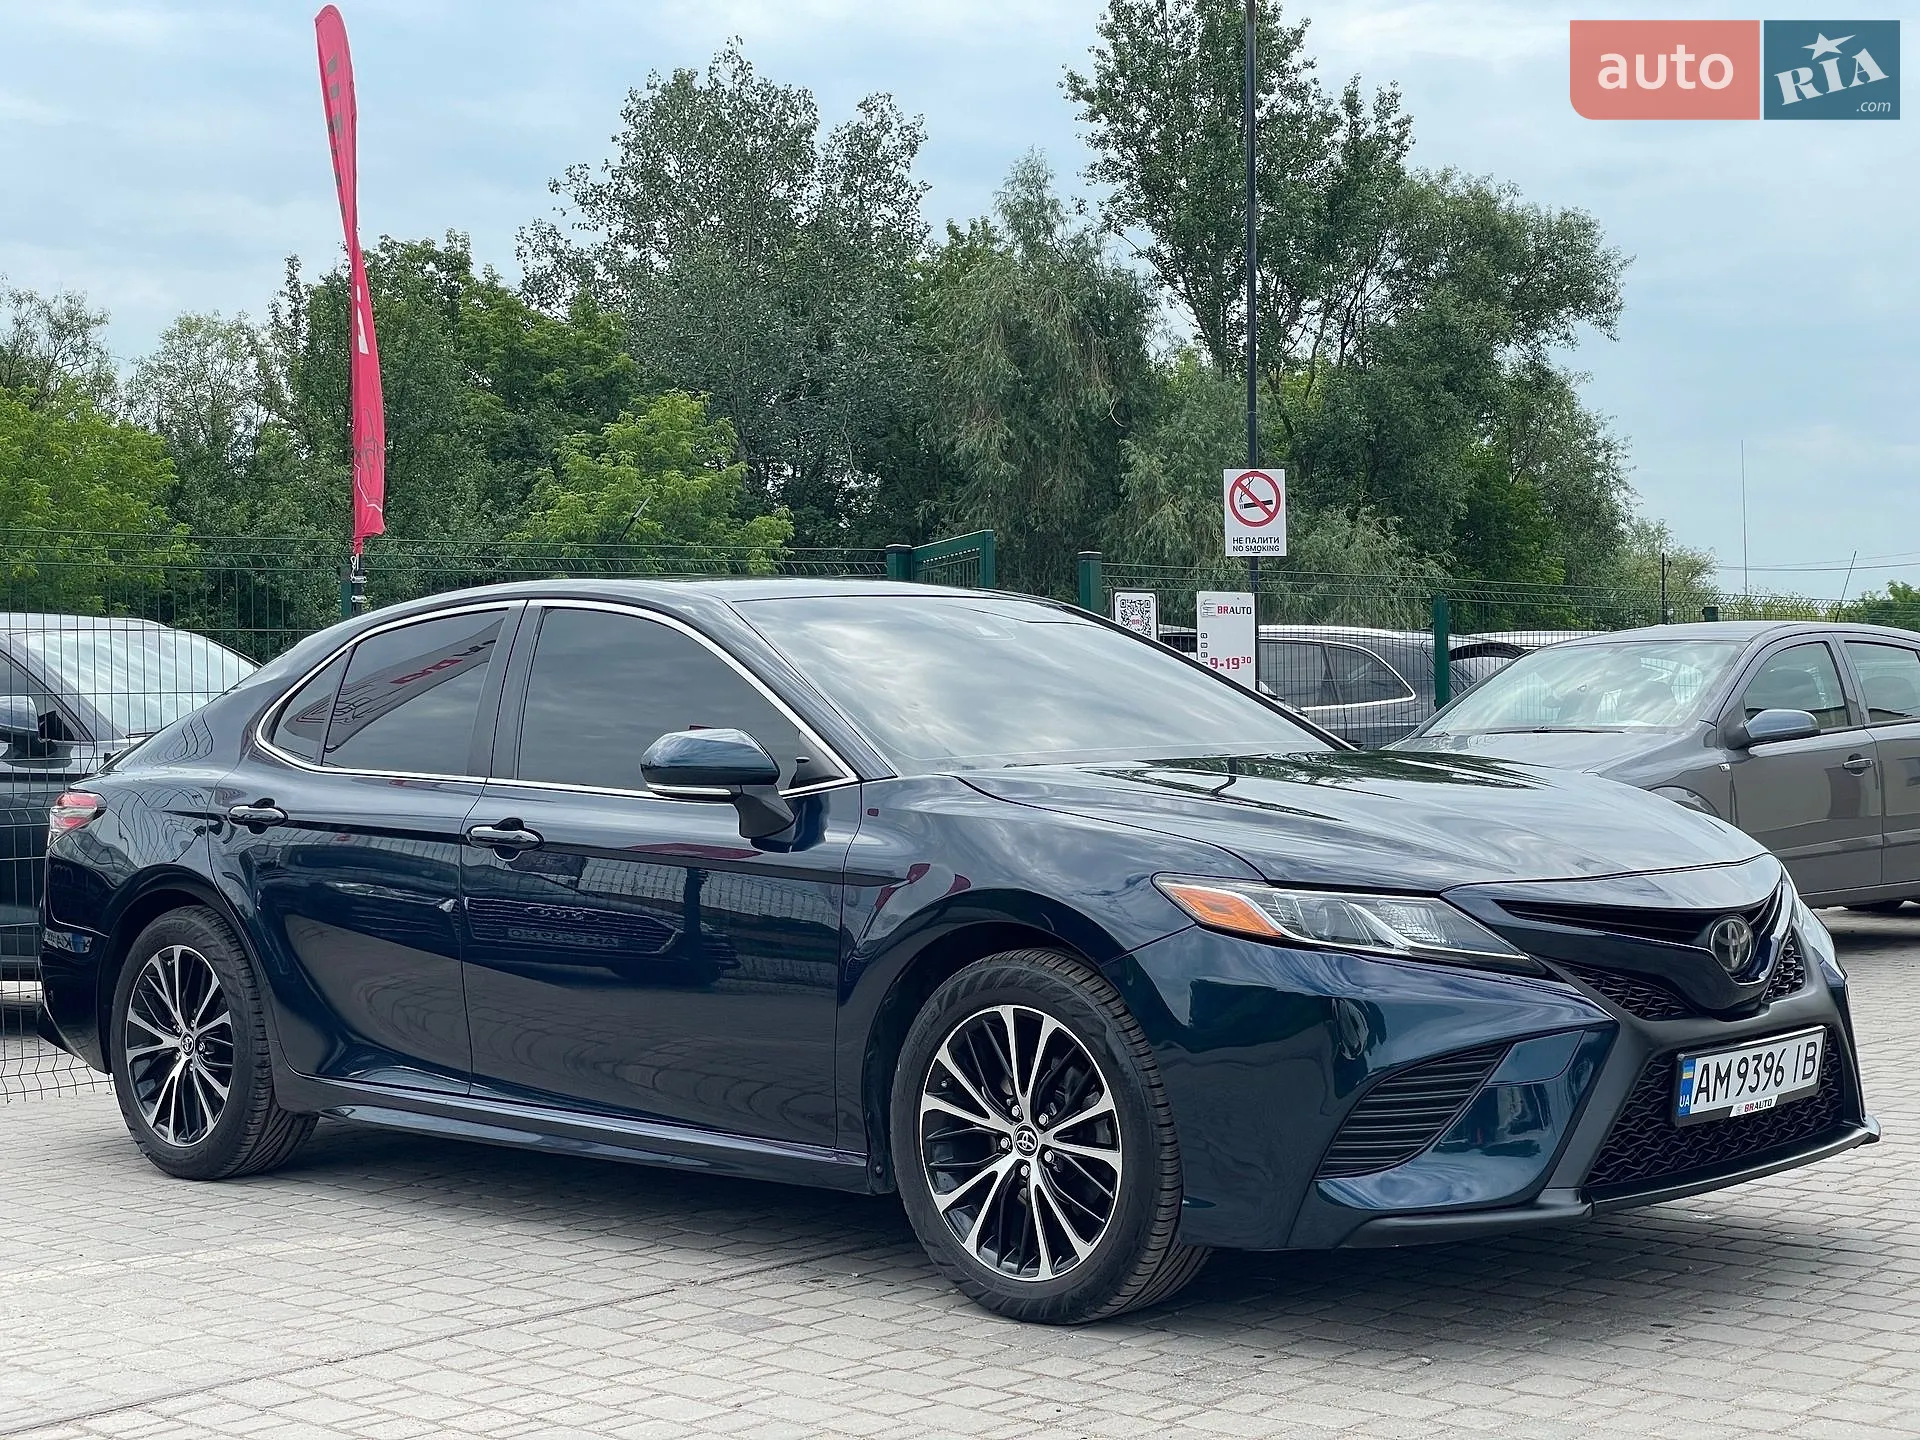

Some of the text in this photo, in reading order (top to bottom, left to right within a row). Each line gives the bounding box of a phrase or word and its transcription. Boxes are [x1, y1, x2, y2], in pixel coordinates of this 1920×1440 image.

[1232, 536, 1280, 545] НЕ ПАЛИТИ
[1217, 605, 1252, 616] BRAUTO
[1793, 1041, 1818, 1083] IB
[1679, 1095, 1690, 1108] UA
[1744, 1098, 1773, 1113] BRAUTO
